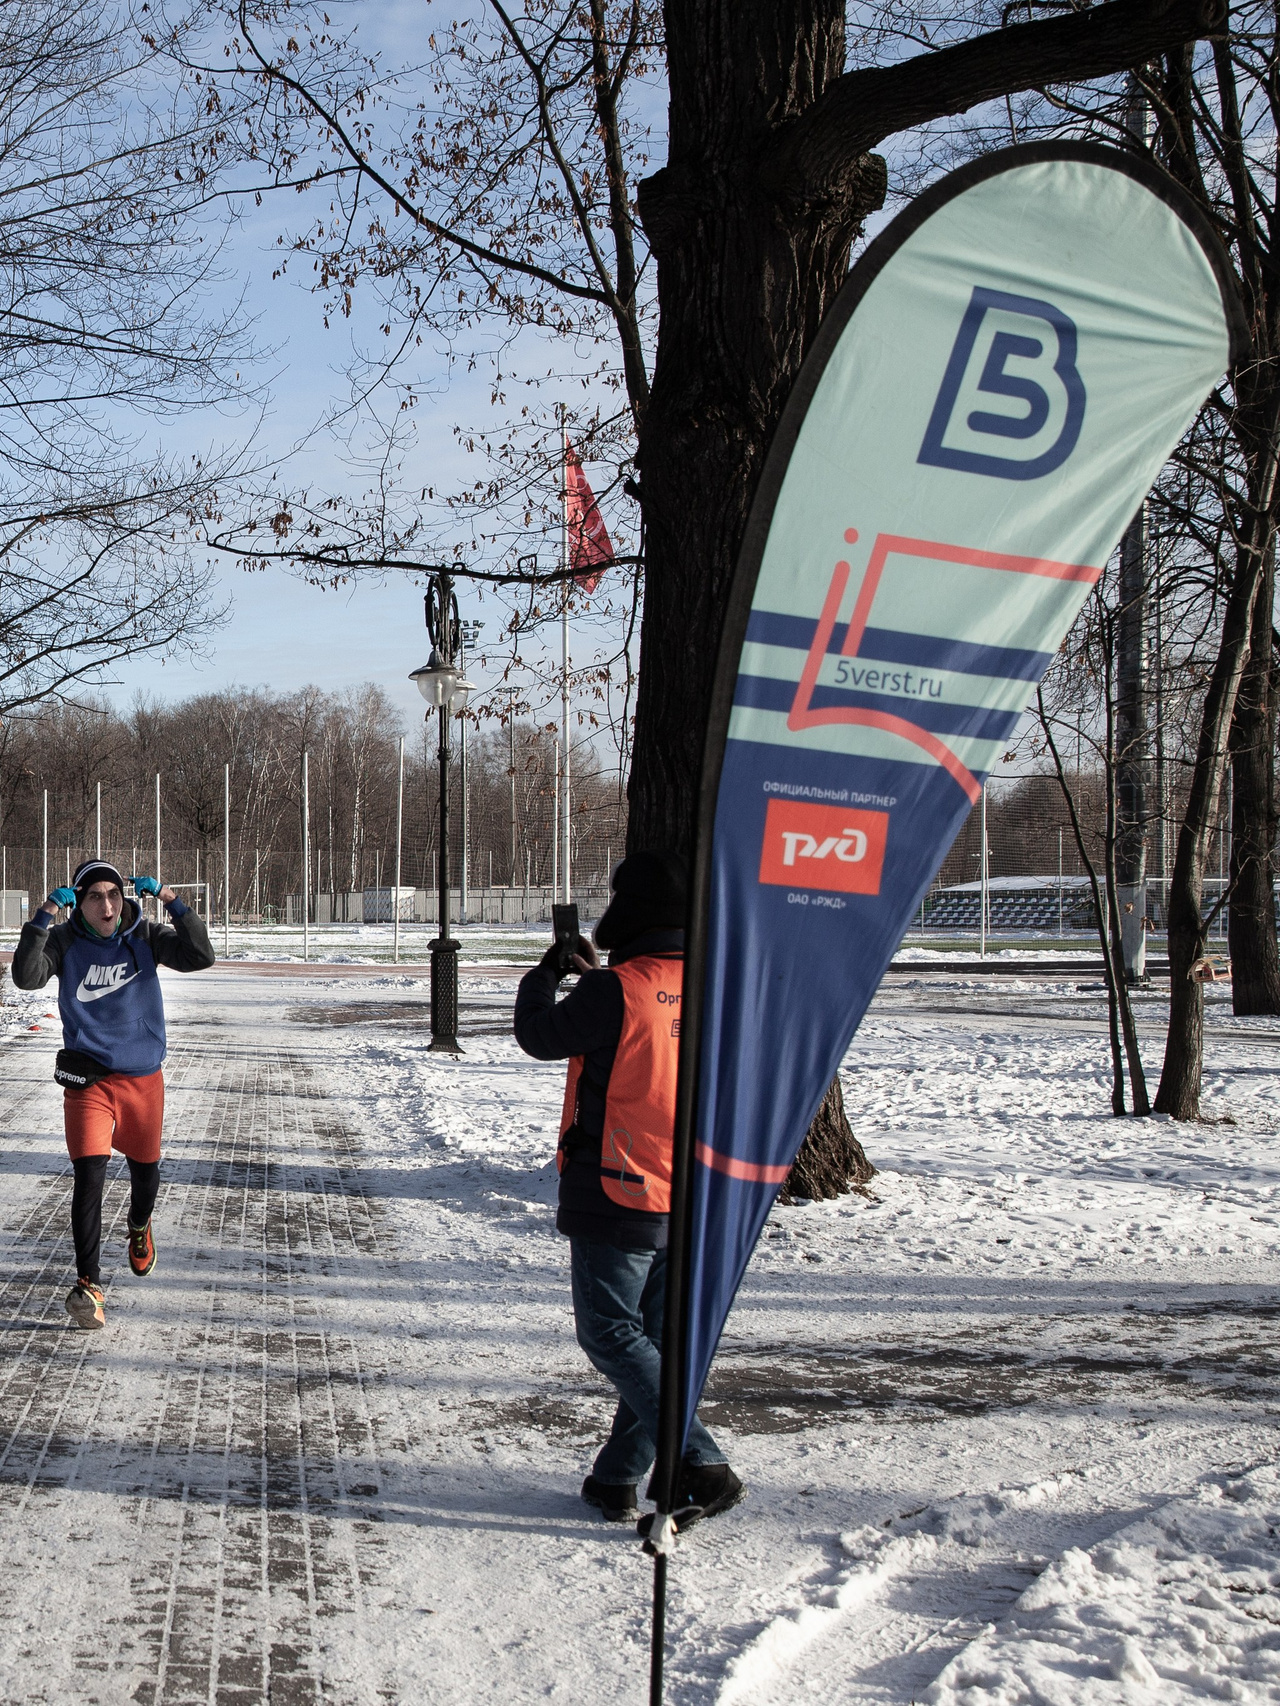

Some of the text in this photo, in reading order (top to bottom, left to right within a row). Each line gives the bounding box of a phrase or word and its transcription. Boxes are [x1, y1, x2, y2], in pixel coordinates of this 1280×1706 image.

[834, 659, 943, 698] 5verst.ru
[763, 781, 897, 807] ОФИЦИАЛЬНЫЙ ПАРТНЕР
[787, 893, 809, 905] ОАО
[84, 962, 128, 986] NIKE
[55, 1068, 86, 1084] upreme
